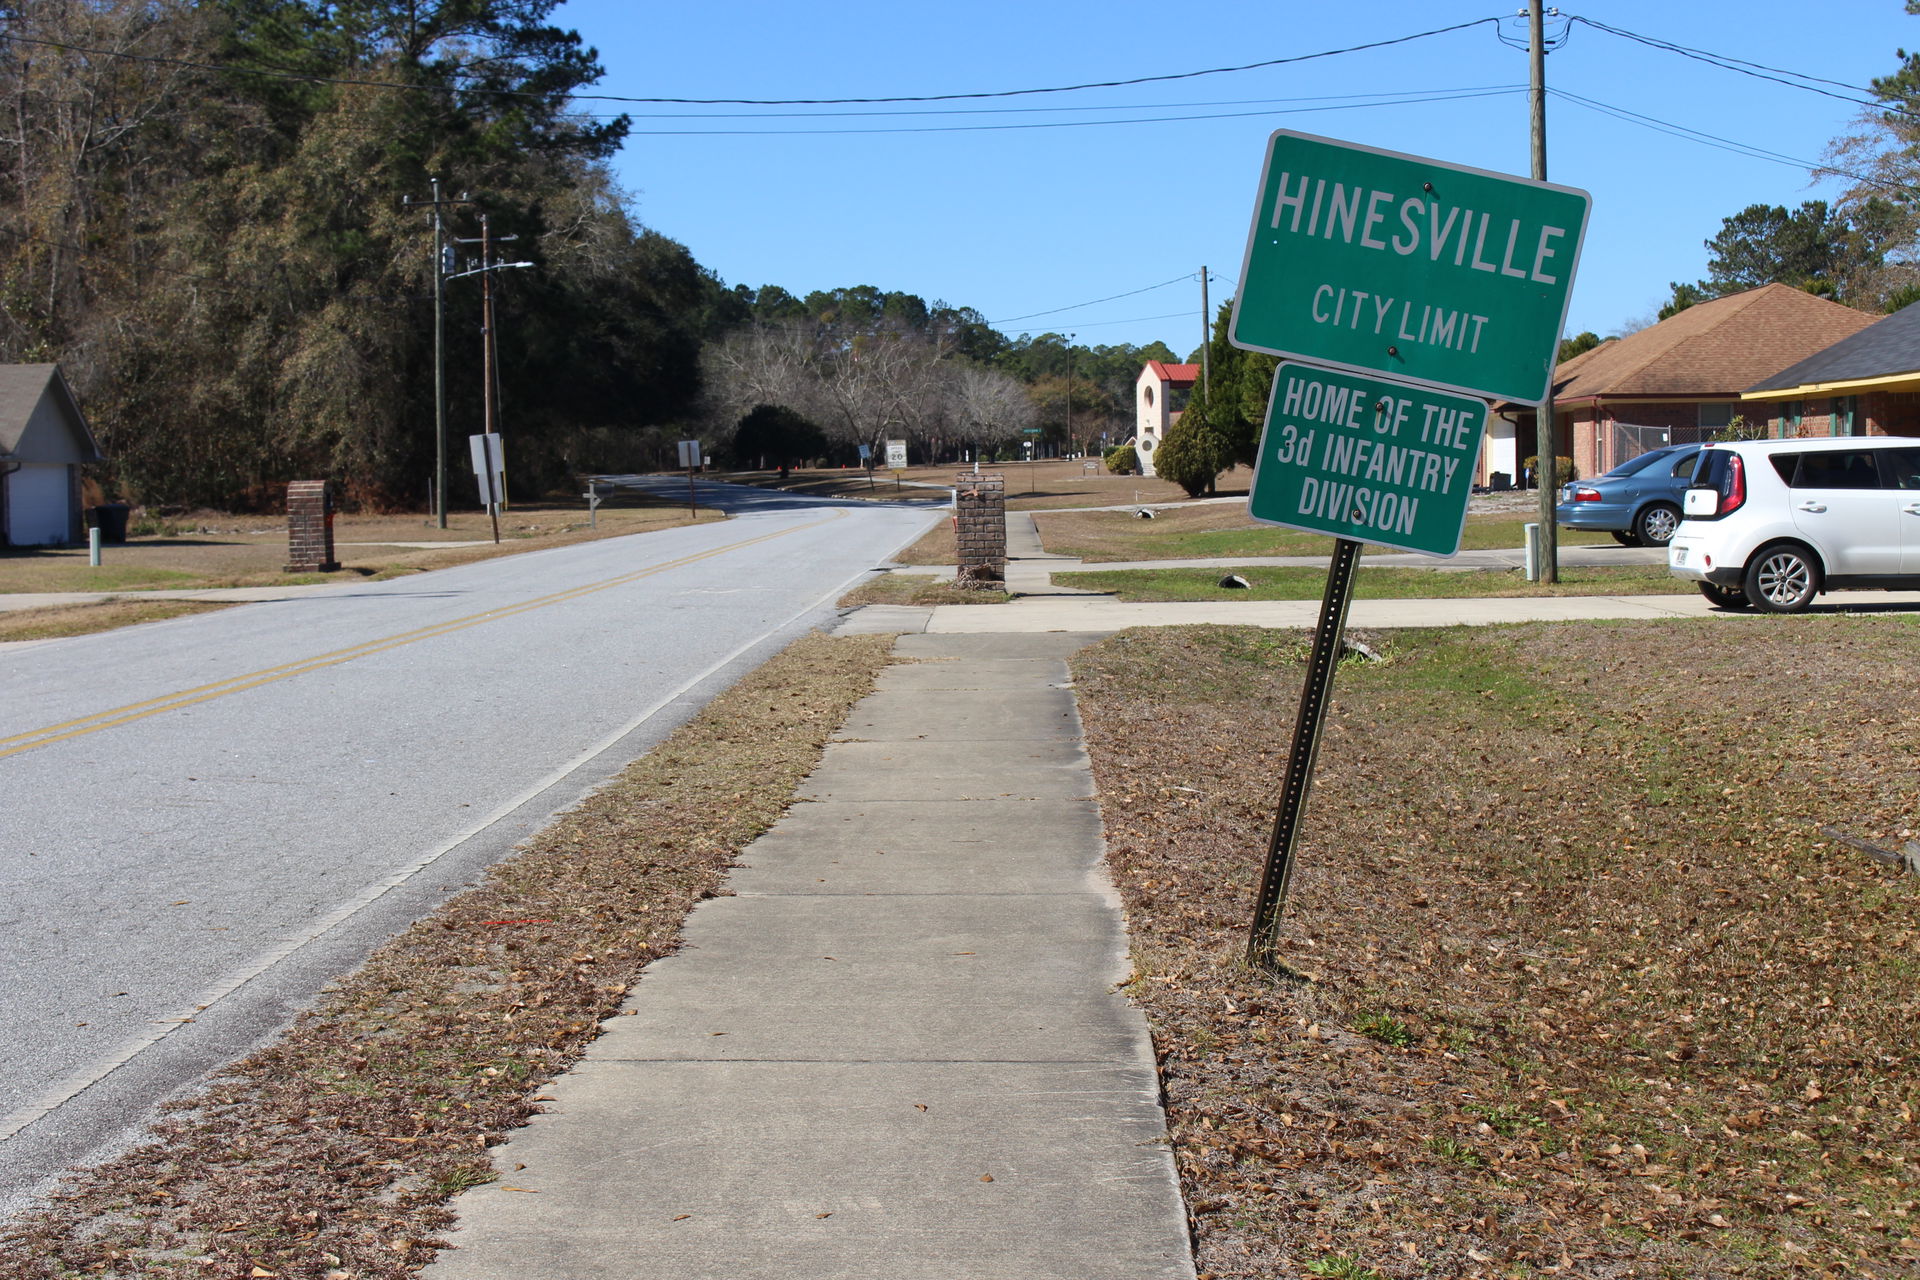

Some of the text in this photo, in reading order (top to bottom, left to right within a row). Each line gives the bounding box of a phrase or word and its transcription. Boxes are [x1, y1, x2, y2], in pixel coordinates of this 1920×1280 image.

[1271, 172, 1566, 285] HINESVILLE
[1312, 284, 1489, 354] CITY LIMIT
[1282, 377, 1474, 450] HOME OF THE
[891, 453, 903, 461] 20
[1277, 424, 1460, 495] 3d INFANTRY
[1297, 476, 1419, 535] DIVISION
